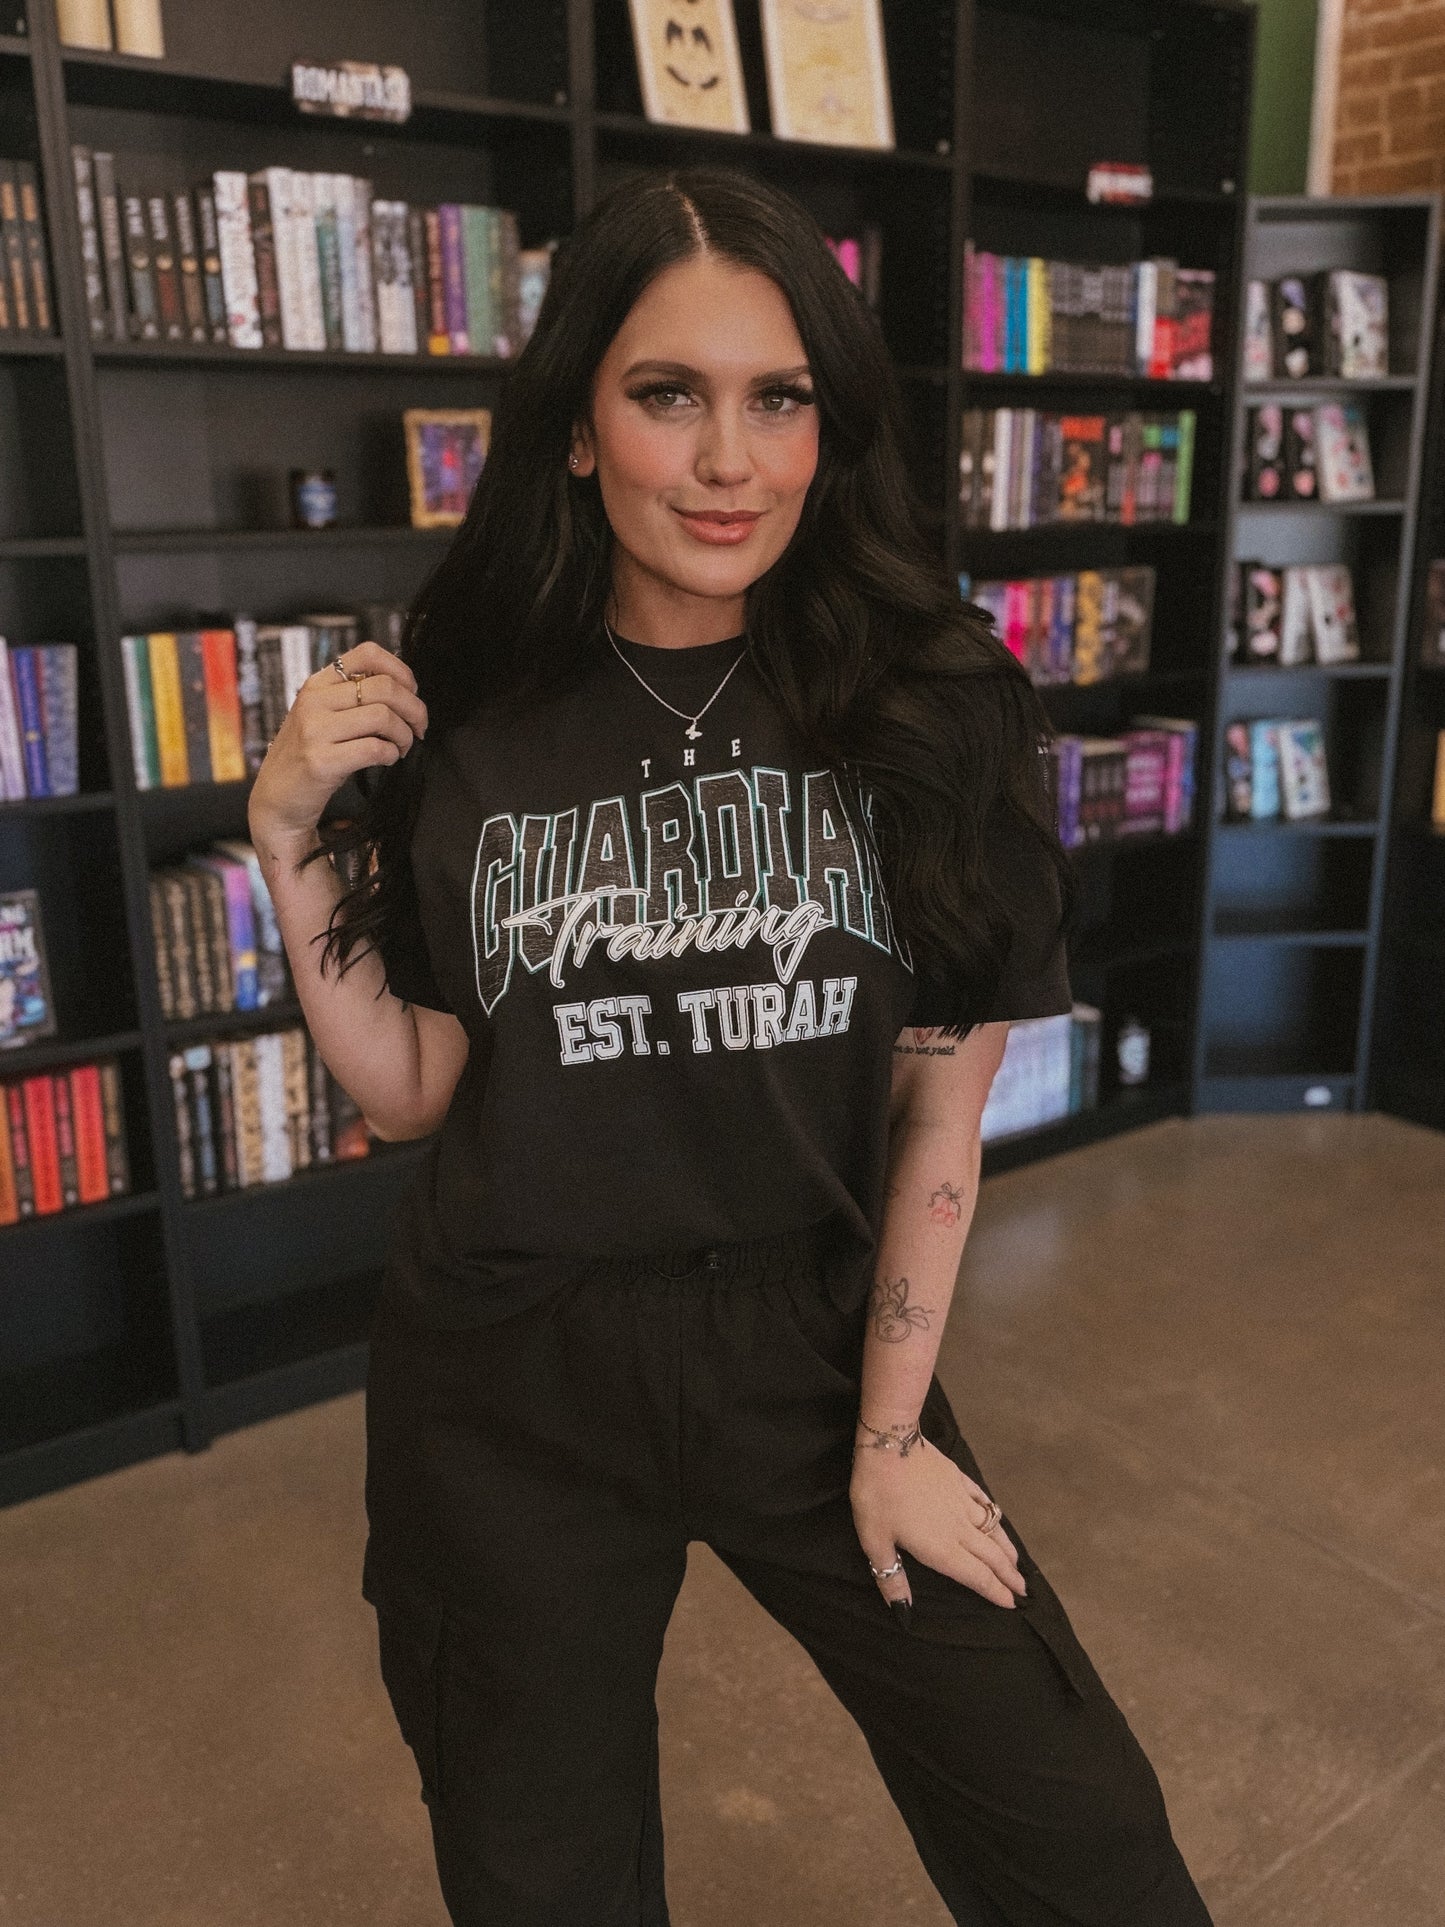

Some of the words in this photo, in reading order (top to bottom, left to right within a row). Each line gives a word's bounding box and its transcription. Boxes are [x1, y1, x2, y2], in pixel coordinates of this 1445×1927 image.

[641, 738, 741, 778] THE
[502, 890, 836, 989] Training
[553, 996, 670, 1066] EST.
[677, 977, 858, 1054] TURAH
